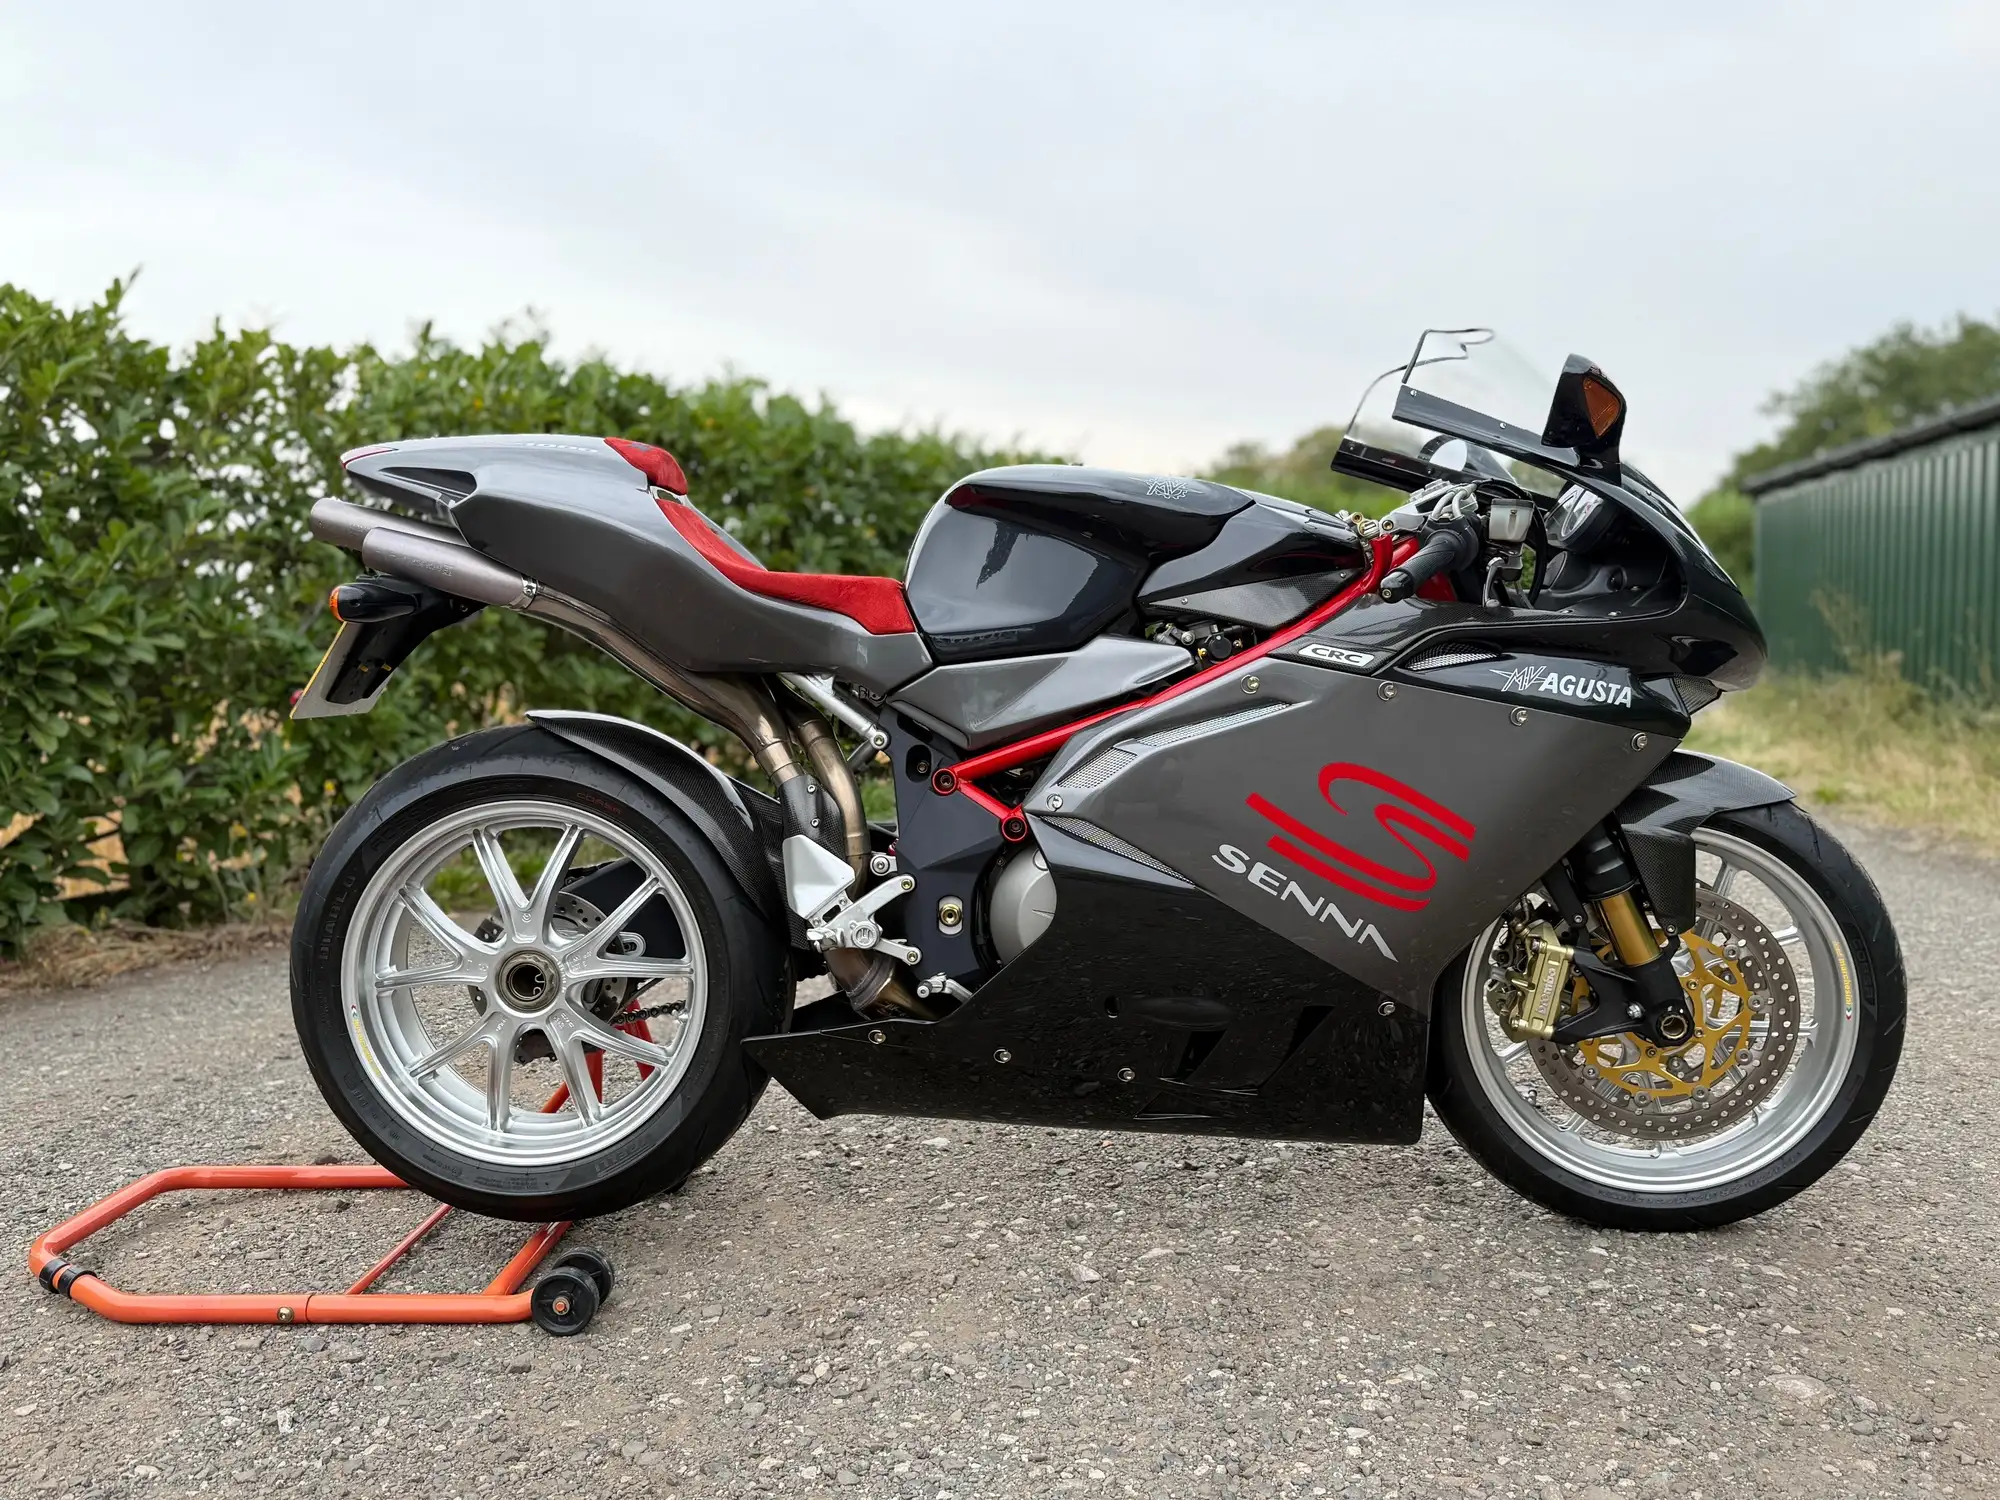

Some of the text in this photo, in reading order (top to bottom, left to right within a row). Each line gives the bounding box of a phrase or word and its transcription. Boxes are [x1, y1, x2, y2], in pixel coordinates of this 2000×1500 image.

[1311, 647, 1363, 664] CRC
[1490, 665, 1632, 709] MV AGUSTA
[317, 872, 357, 961] DIABLO
[1211, 843, 1399, 963] SENNA
[1535, 967, 1557, 1017] brembo
